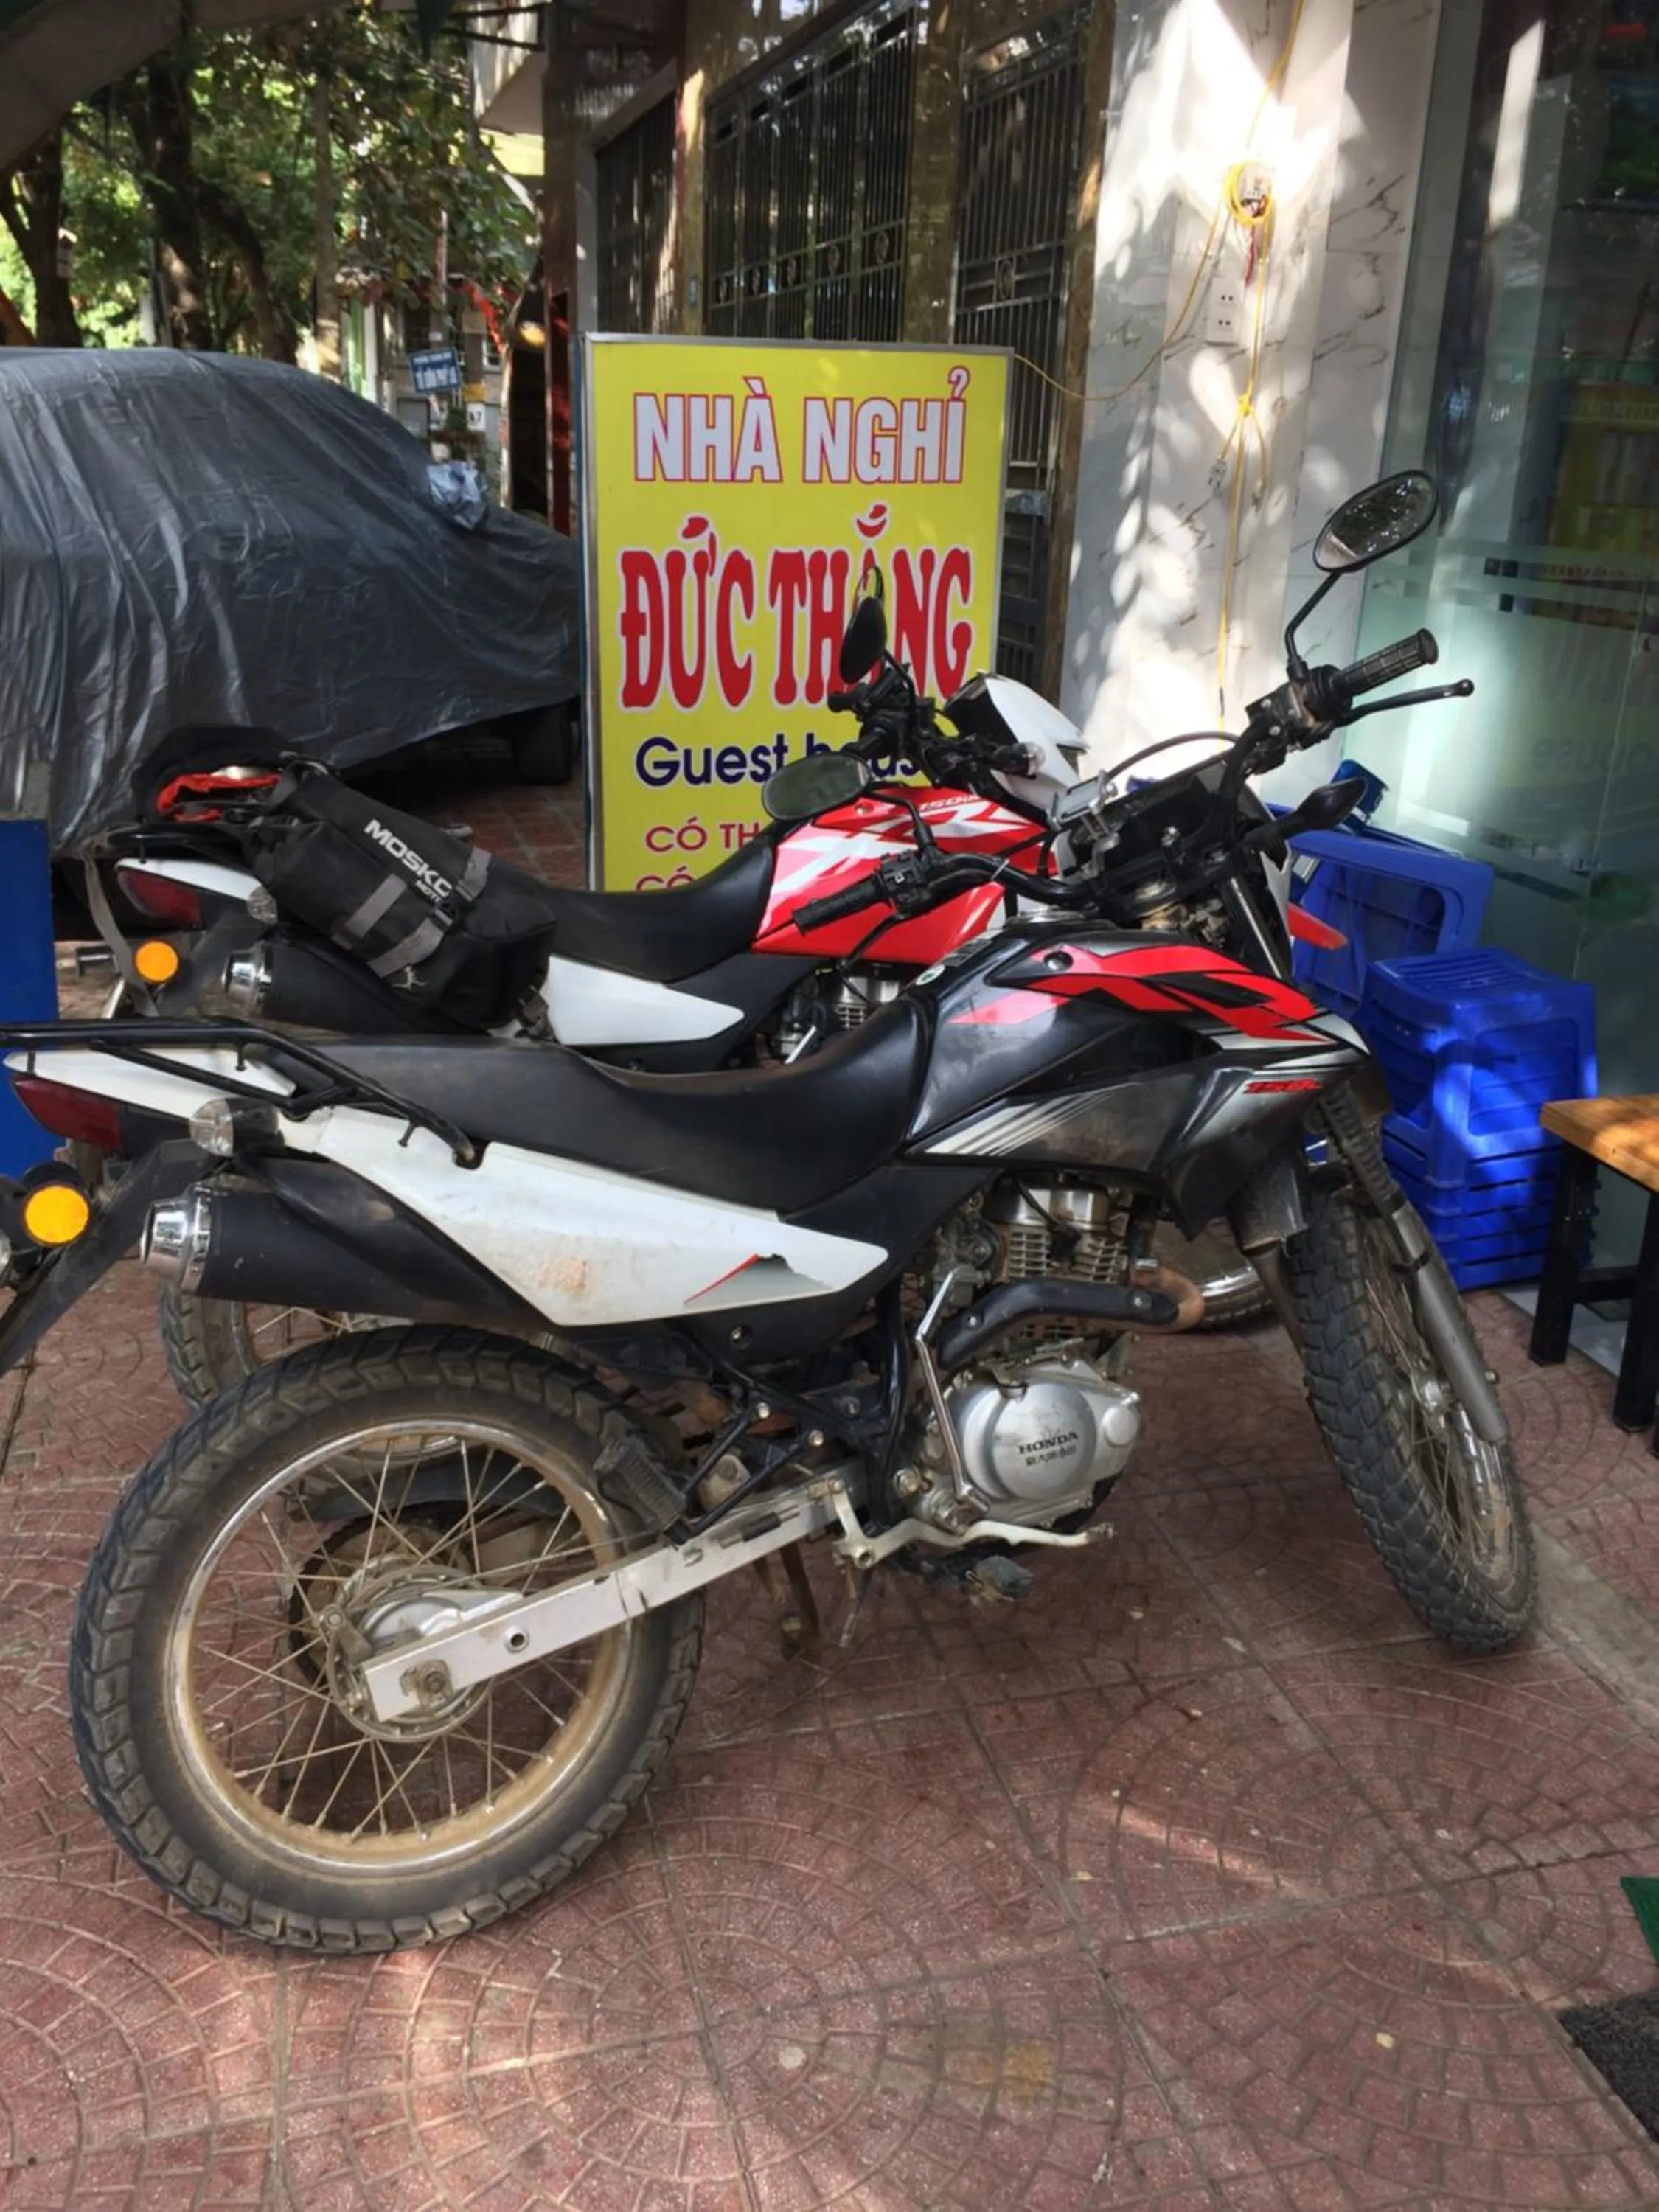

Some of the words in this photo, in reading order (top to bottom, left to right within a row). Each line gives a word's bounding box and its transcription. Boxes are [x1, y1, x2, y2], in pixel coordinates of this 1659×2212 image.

[633, 376, 784, 484] NHÀ
[801, 366, 970, 485] NGHỈ
[620, 515, 754, 709] ĐỨC
[635, 734, 788, 787] Guest
[645, 818, 708, 852] CÓ
[1018, 1431, 1078, 1454] HONDA
